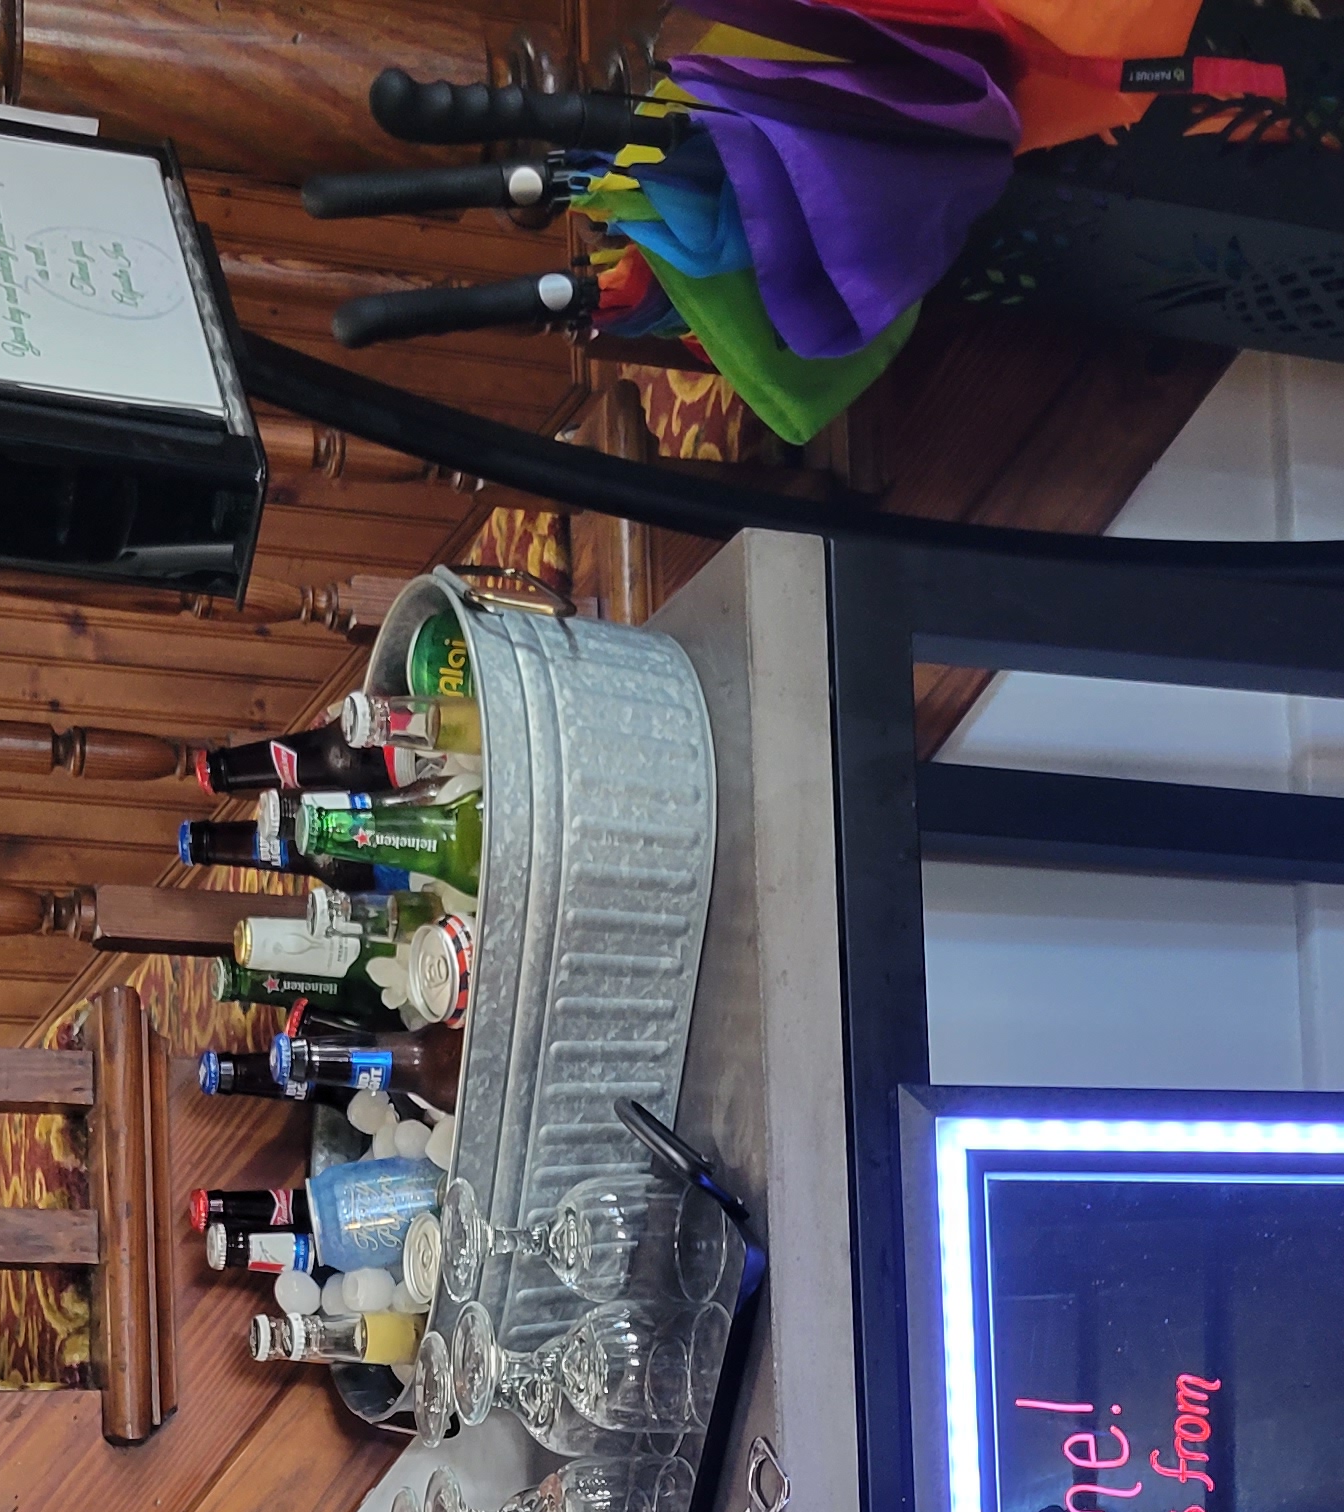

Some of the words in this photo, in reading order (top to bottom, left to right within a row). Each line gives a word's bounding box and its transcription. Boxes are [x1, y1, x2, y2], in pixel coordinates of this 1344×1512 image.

[67, 259, 96, 296] Thank
[0, 326, 41, 357] Your
[373, 833, 437, 852] Heineken
[281, 979, 338, 995] Heineken
[1150, 1372, 1222, 1493] from
